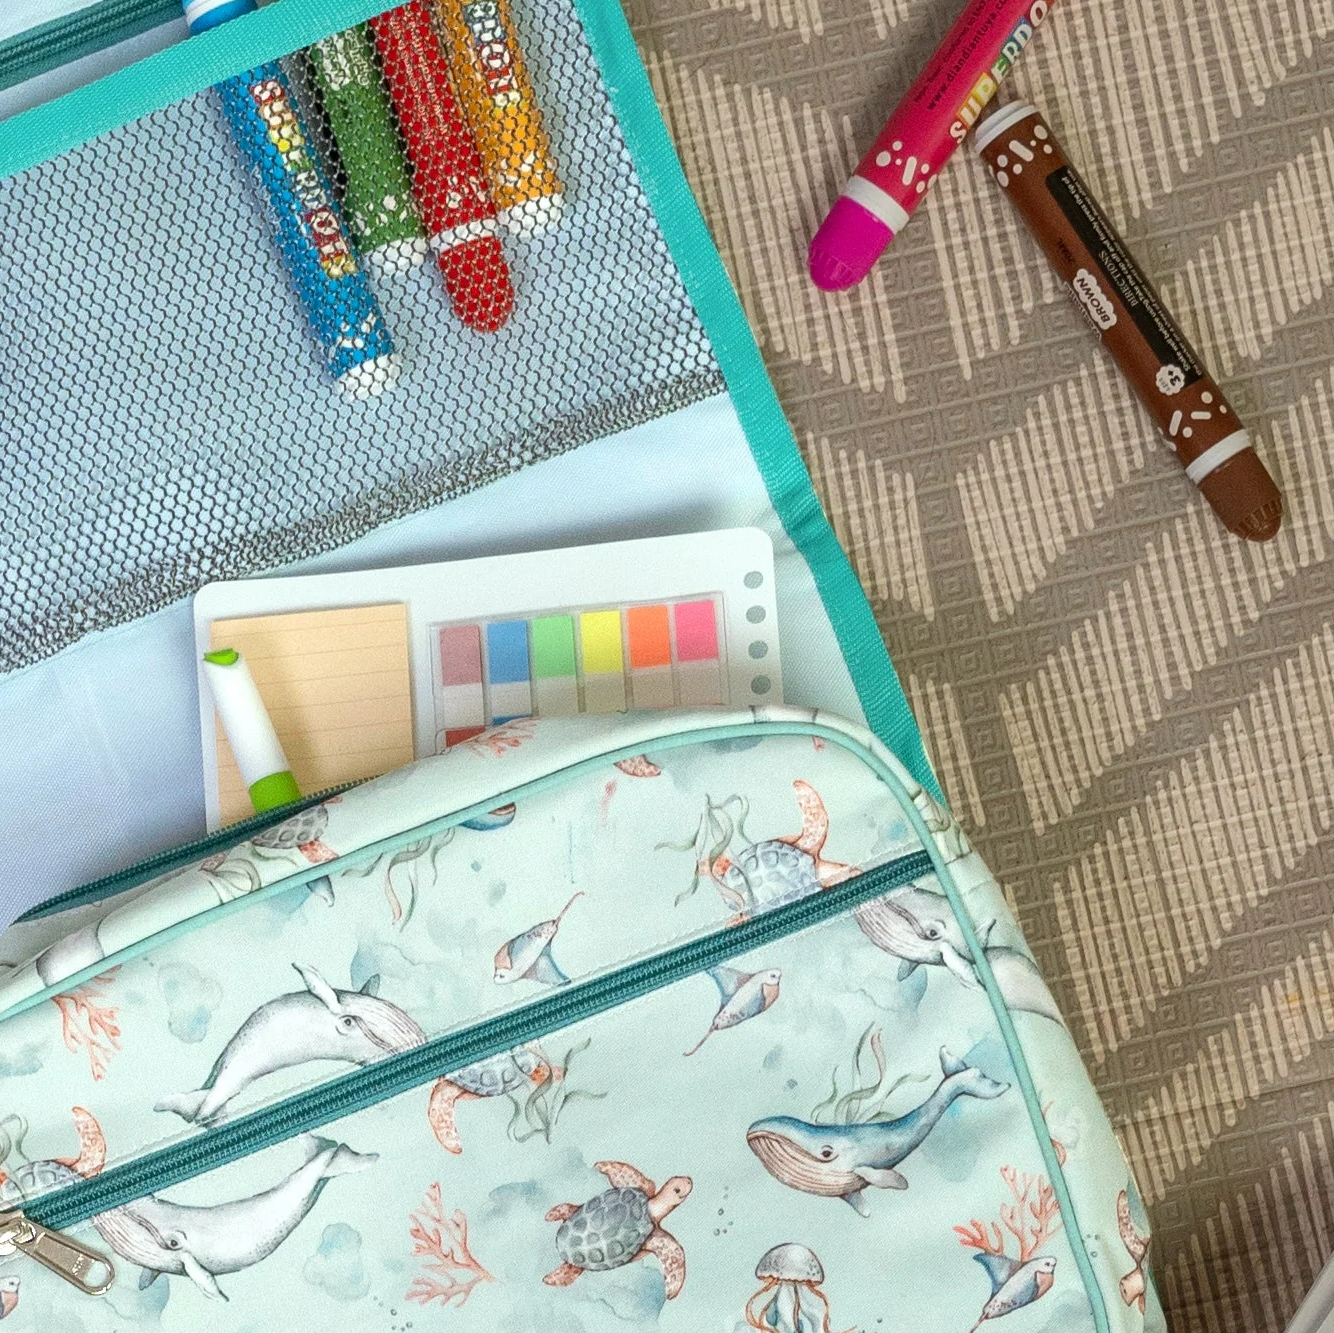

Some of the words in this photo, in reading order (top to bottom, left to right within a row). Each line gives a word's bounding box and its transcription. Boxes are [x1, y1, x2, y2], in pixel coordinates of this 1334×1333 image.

[1102, 238, 1115, 253] and
[1097, 248, 1139, 308] DIRECTIONS
[1076, 275, 1110, 324] BROWN
[1152, 315, 1170, 339] before
[1175, 352, 1191, 372] Shake
[1164, 367, 1181, 387] 3+
